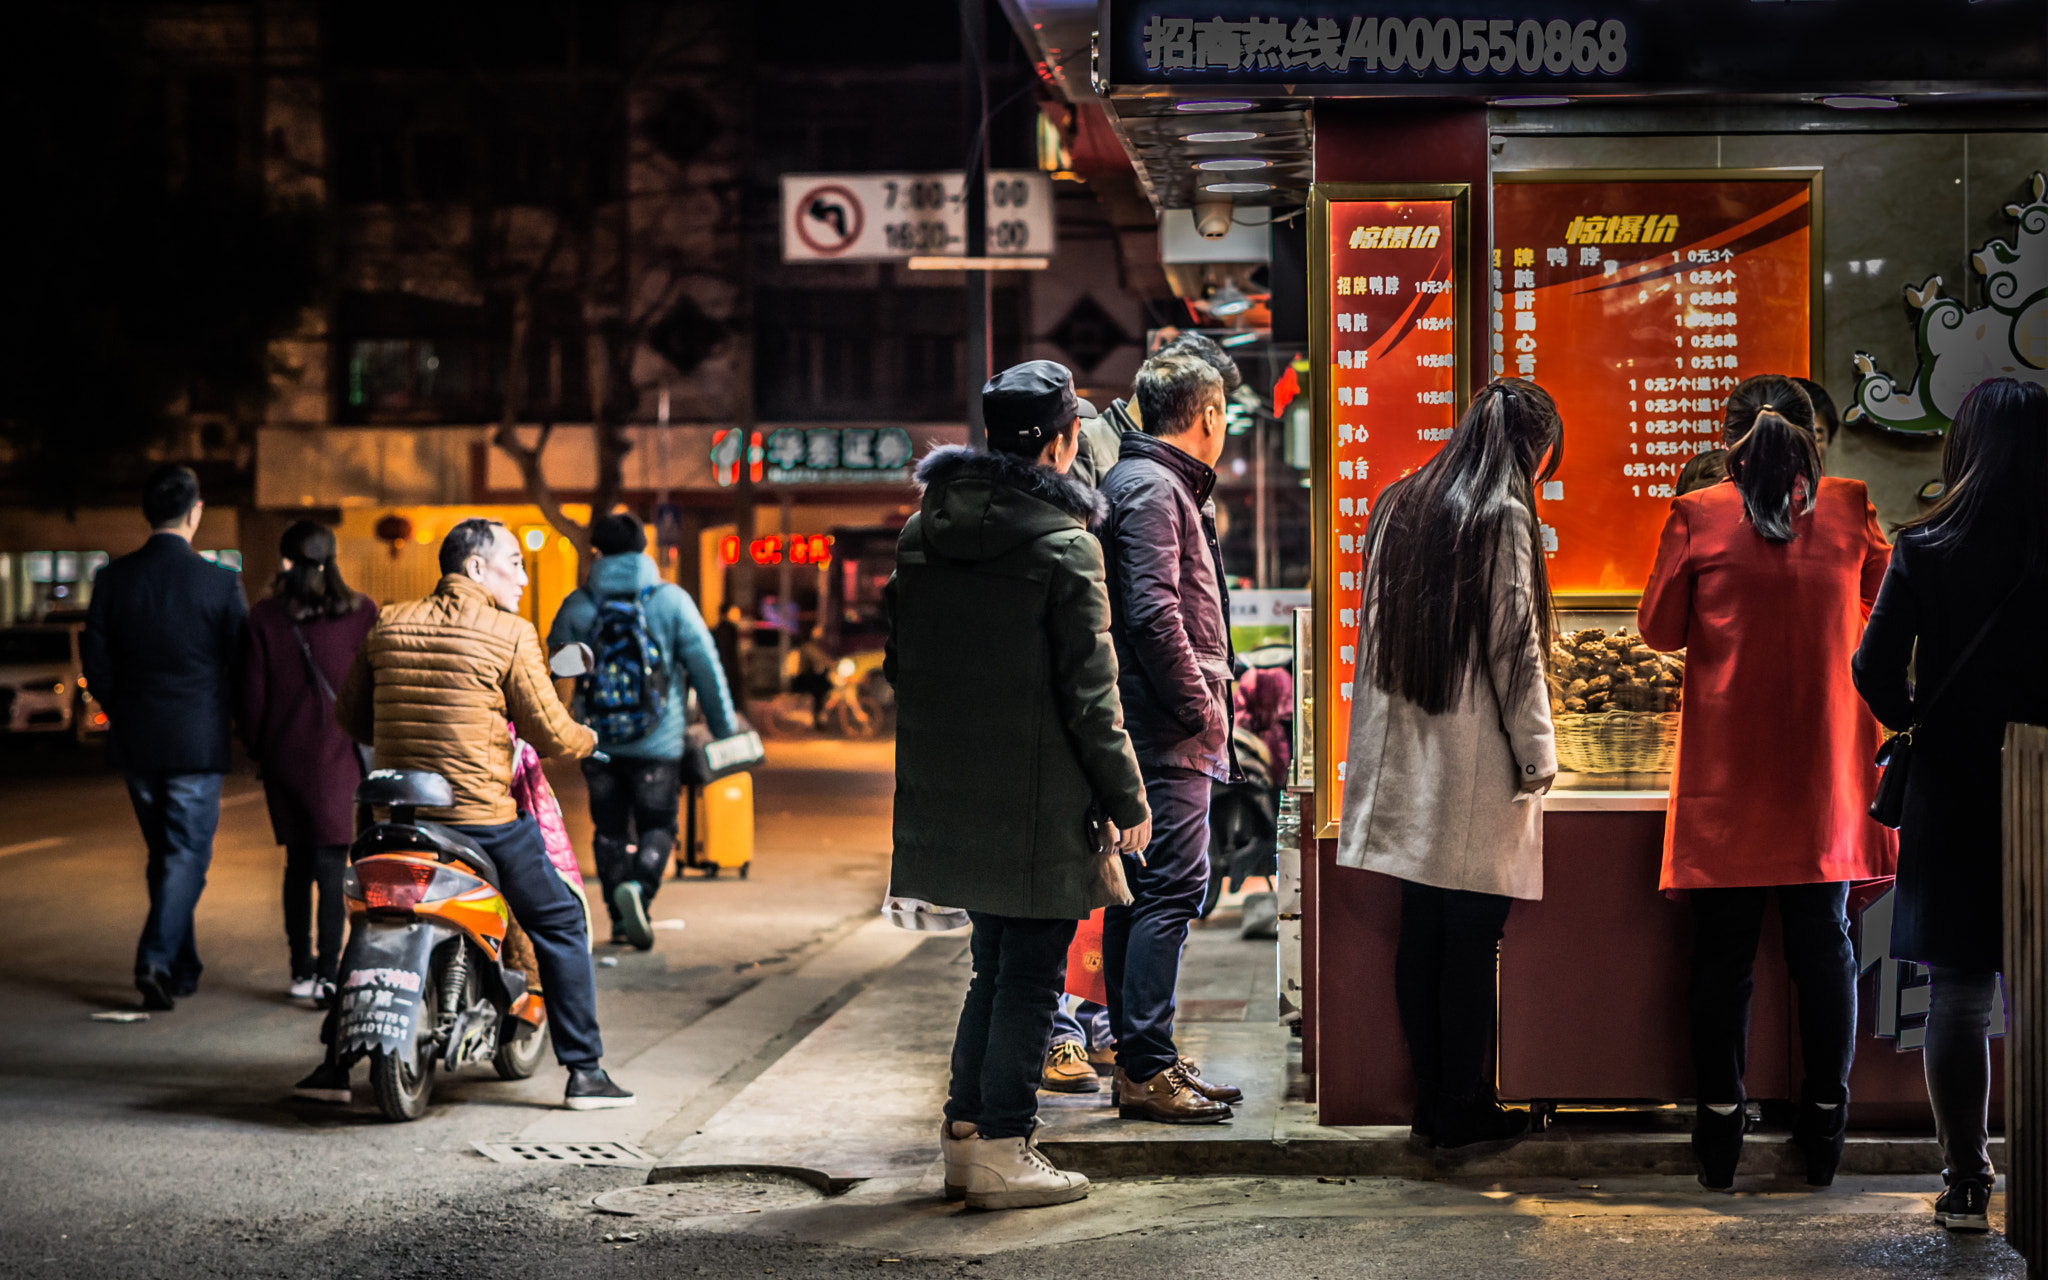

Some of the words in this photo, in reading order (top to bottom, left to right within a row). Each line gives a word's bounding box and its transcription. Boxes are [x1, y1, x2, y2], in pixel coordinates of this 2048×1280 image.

[1348, 225, 1441, 250] 惊爆价
[1565, 214, 1680, 245] 惊爆价
[1414, 279, 1453, 294] 10元3个
